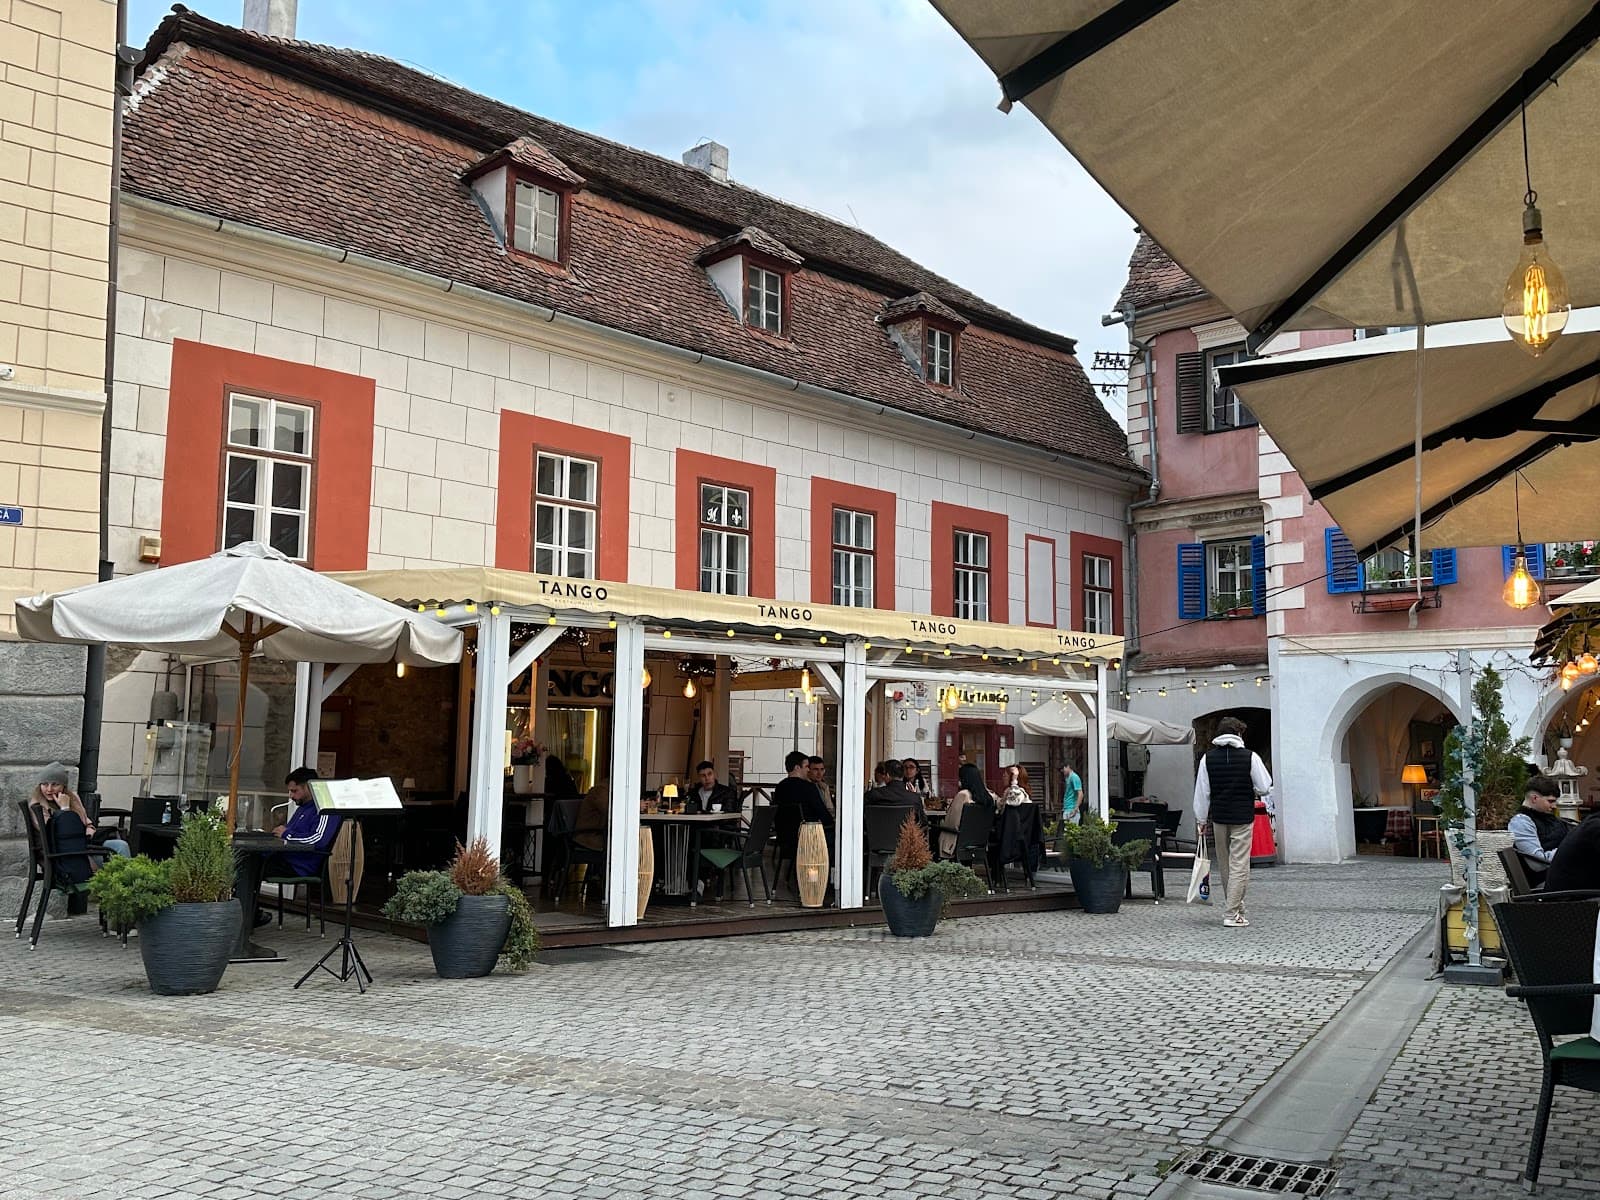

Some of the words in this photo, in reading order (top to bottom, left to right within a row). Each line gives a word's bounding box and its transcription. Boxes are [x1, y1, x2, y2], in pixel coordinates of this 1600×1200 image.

[539, 580, 607, 600] TANGO
[758, 605, 812, 621] TANGO
[911, 620, 956, 635] TANGO
[1057, 635, 1096, 648] TANGO
